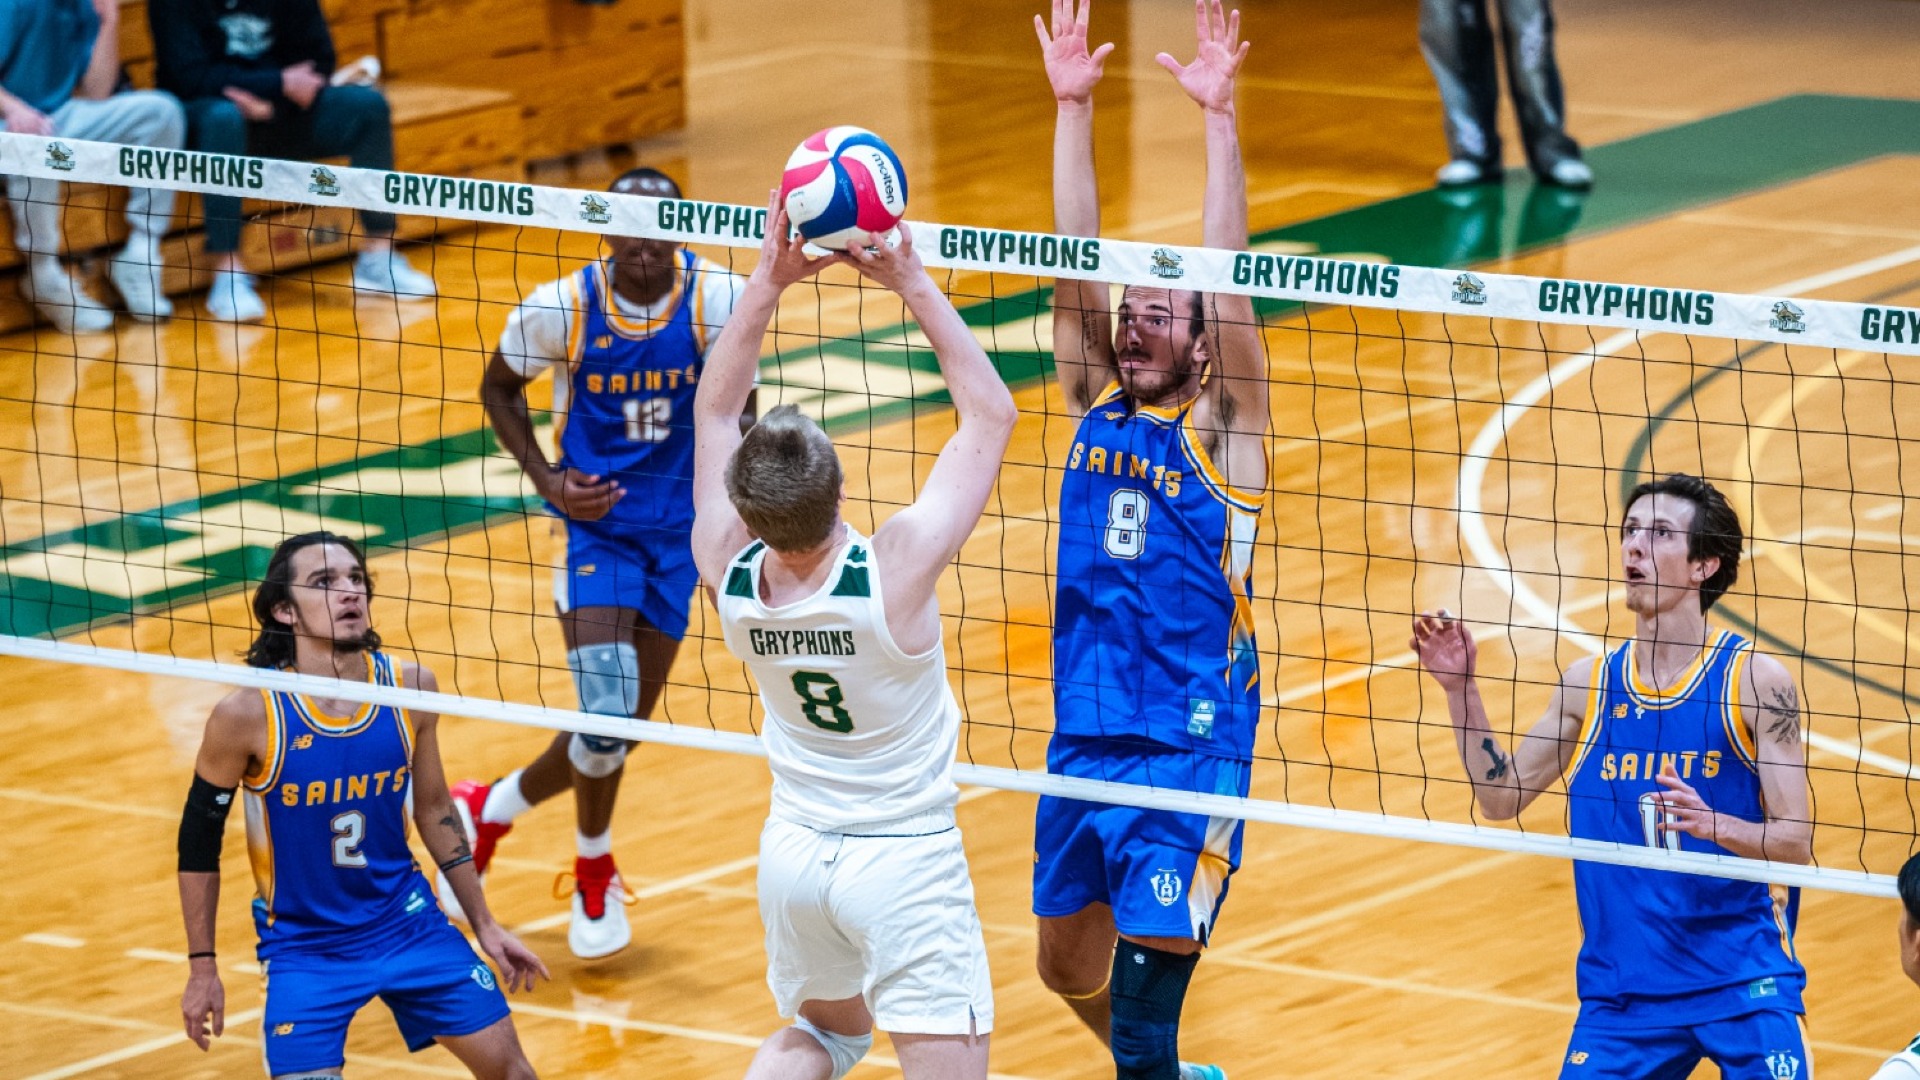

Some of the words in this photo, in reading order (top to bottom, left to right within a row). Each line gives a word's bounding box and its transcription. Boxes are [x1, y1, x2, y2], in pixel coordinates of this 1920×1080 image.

[120, 147, 263, 189] GRYPHONS
[871, 153, 895, 205] molten
[385, 173, 534, 216] GRYPHONS
[658, 200, 768, 241] GRYPHO
[940, 228, 1100, 271] GRYPHONS
[1233, 253, 1399, 298] GRYPHONS
[1538, 280, 1714, 325] GRYPHONS
[622, 397, 672, 443] 12
[1069, 442, 1183, 498] SAINTS
[1104, 487, 1150, 560] 8
[749, 628, 857, 657] GRYPHONS
[790, 670, 855, 734] 8
[280, 765, 408, 807] SAINTS
[1600, 750, 1723, 781] SAINTS
[330, 809, 369, 869] 2
[1638, 791, 1682, 851] 11
